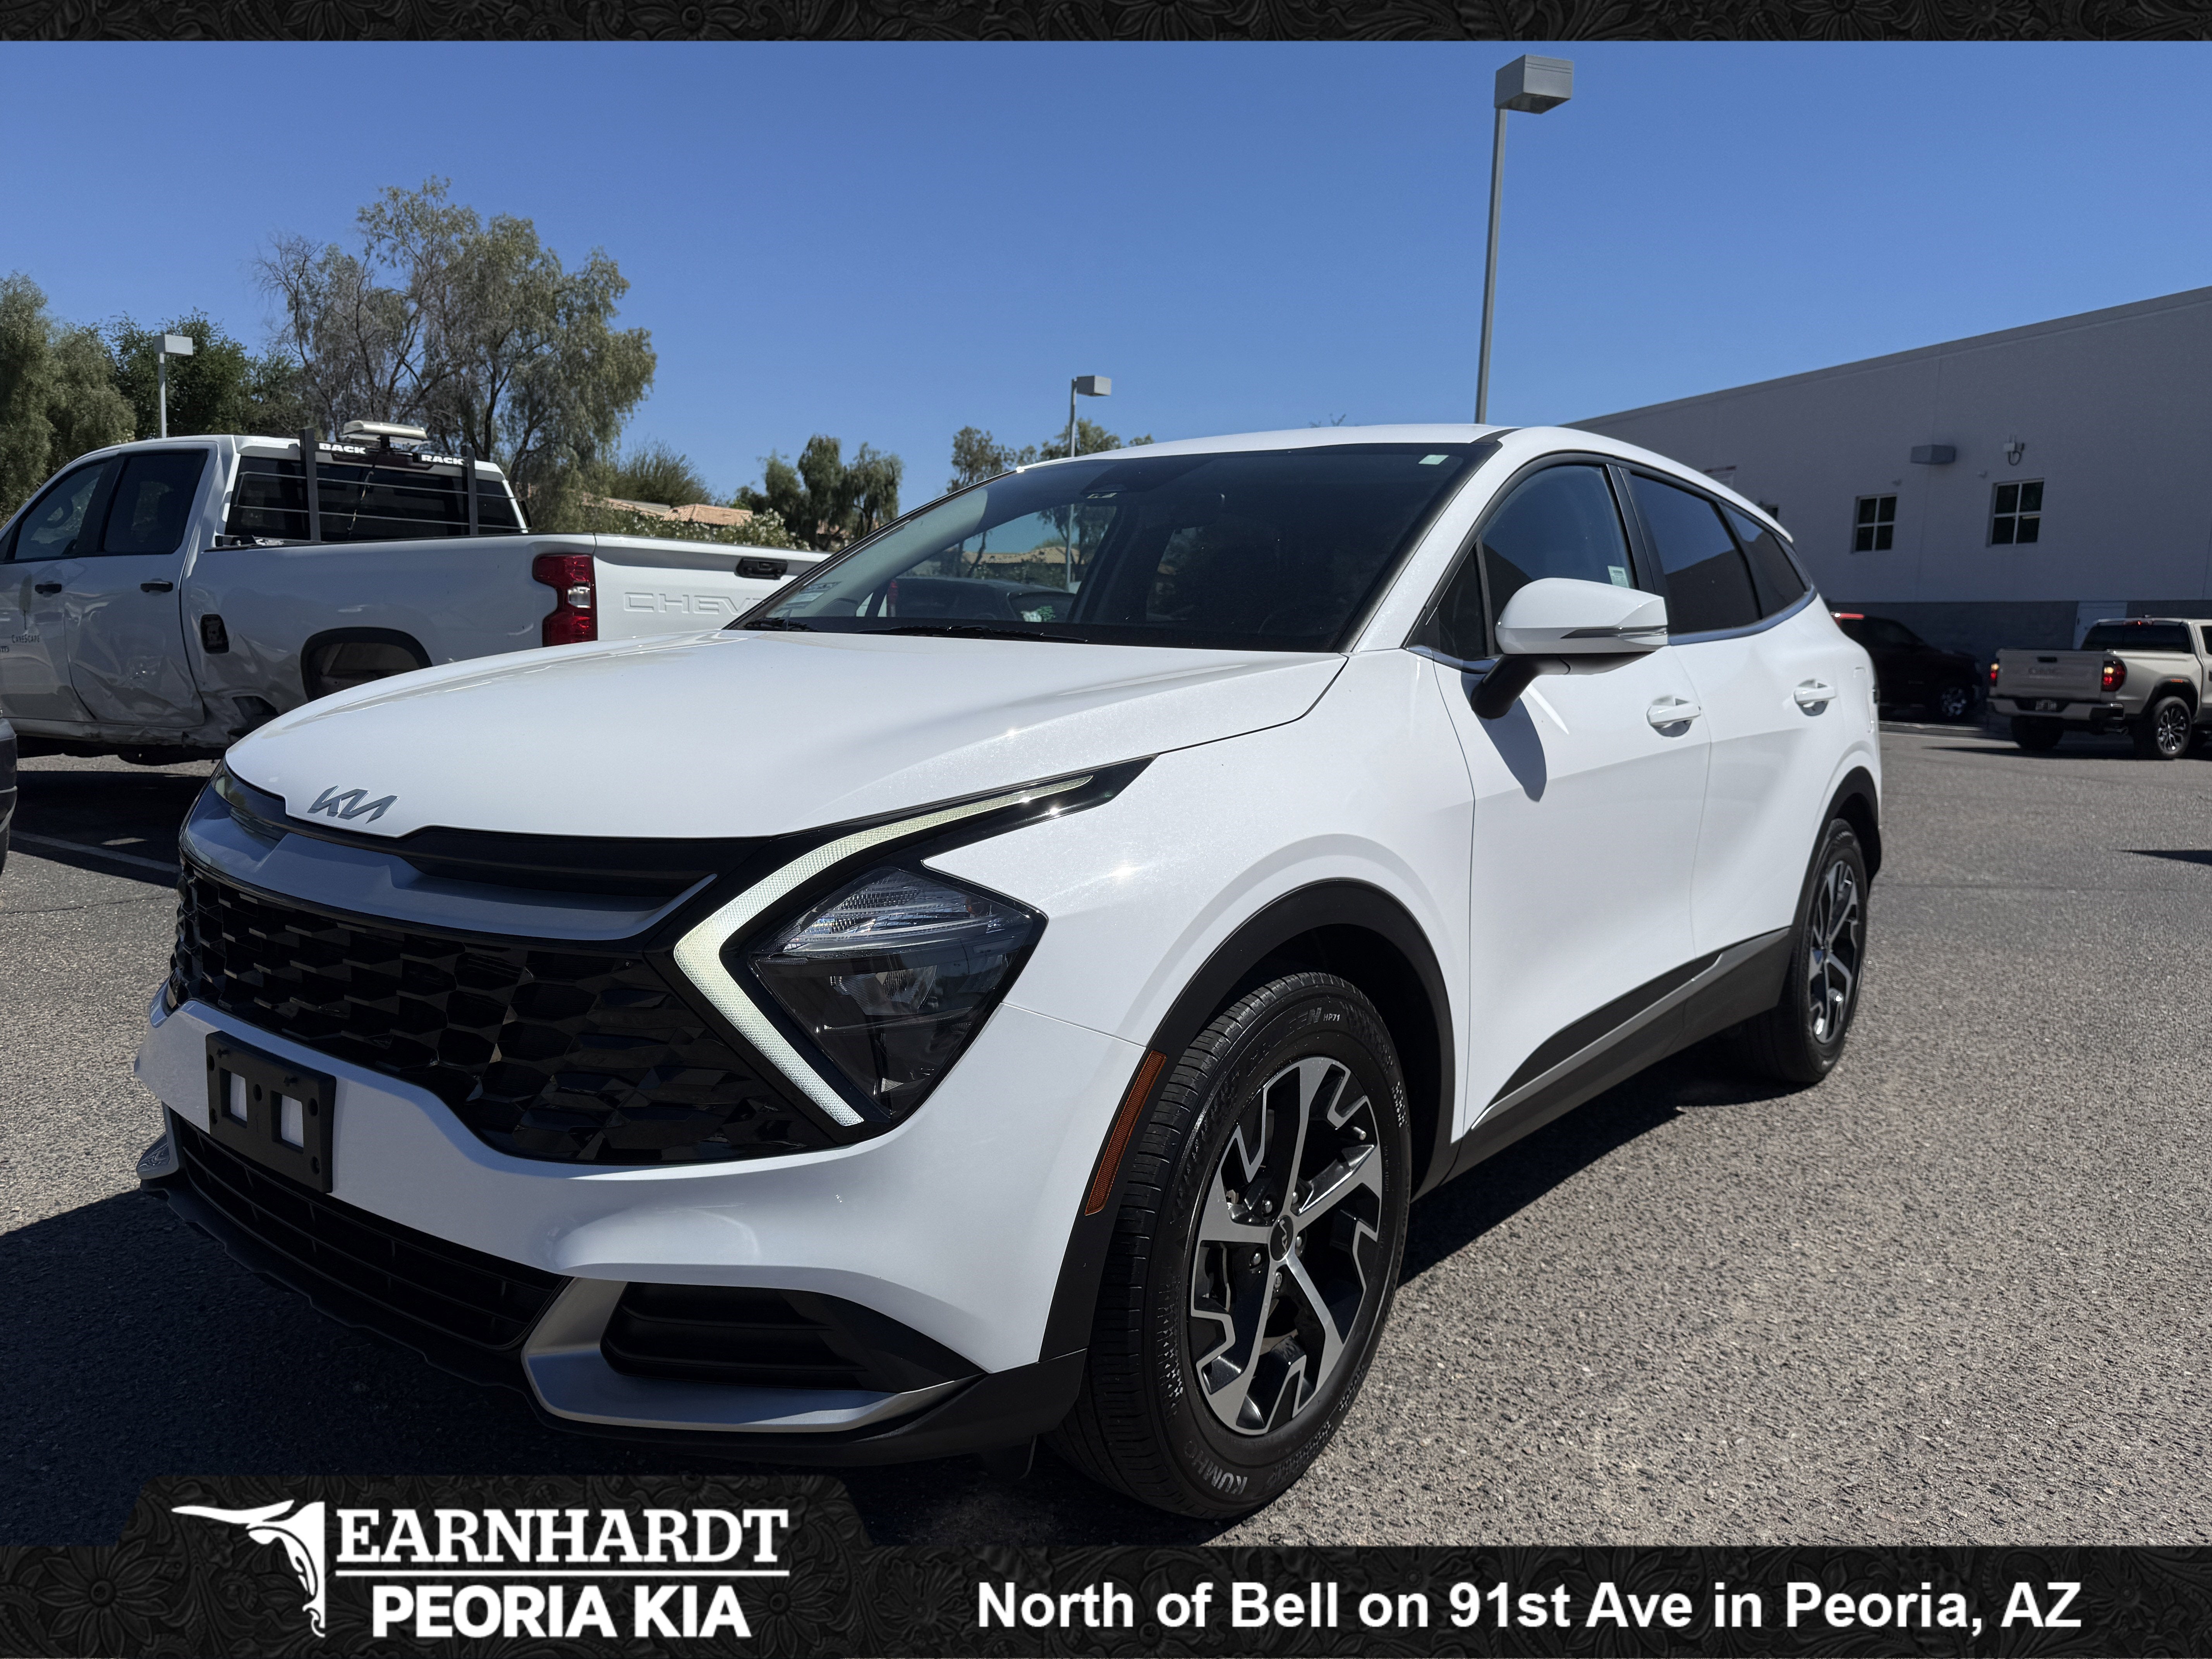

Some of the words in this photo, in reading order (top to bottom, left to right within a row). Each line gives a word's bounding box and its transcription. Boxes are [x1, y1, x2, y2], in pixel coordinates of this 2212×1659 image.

[319, 442, 366, 455] BACK
[421, 454, 465, 465] RACK
[623, 591, 761, 615] CHEV
[1322, 1013, 1341, 1022] HP71
